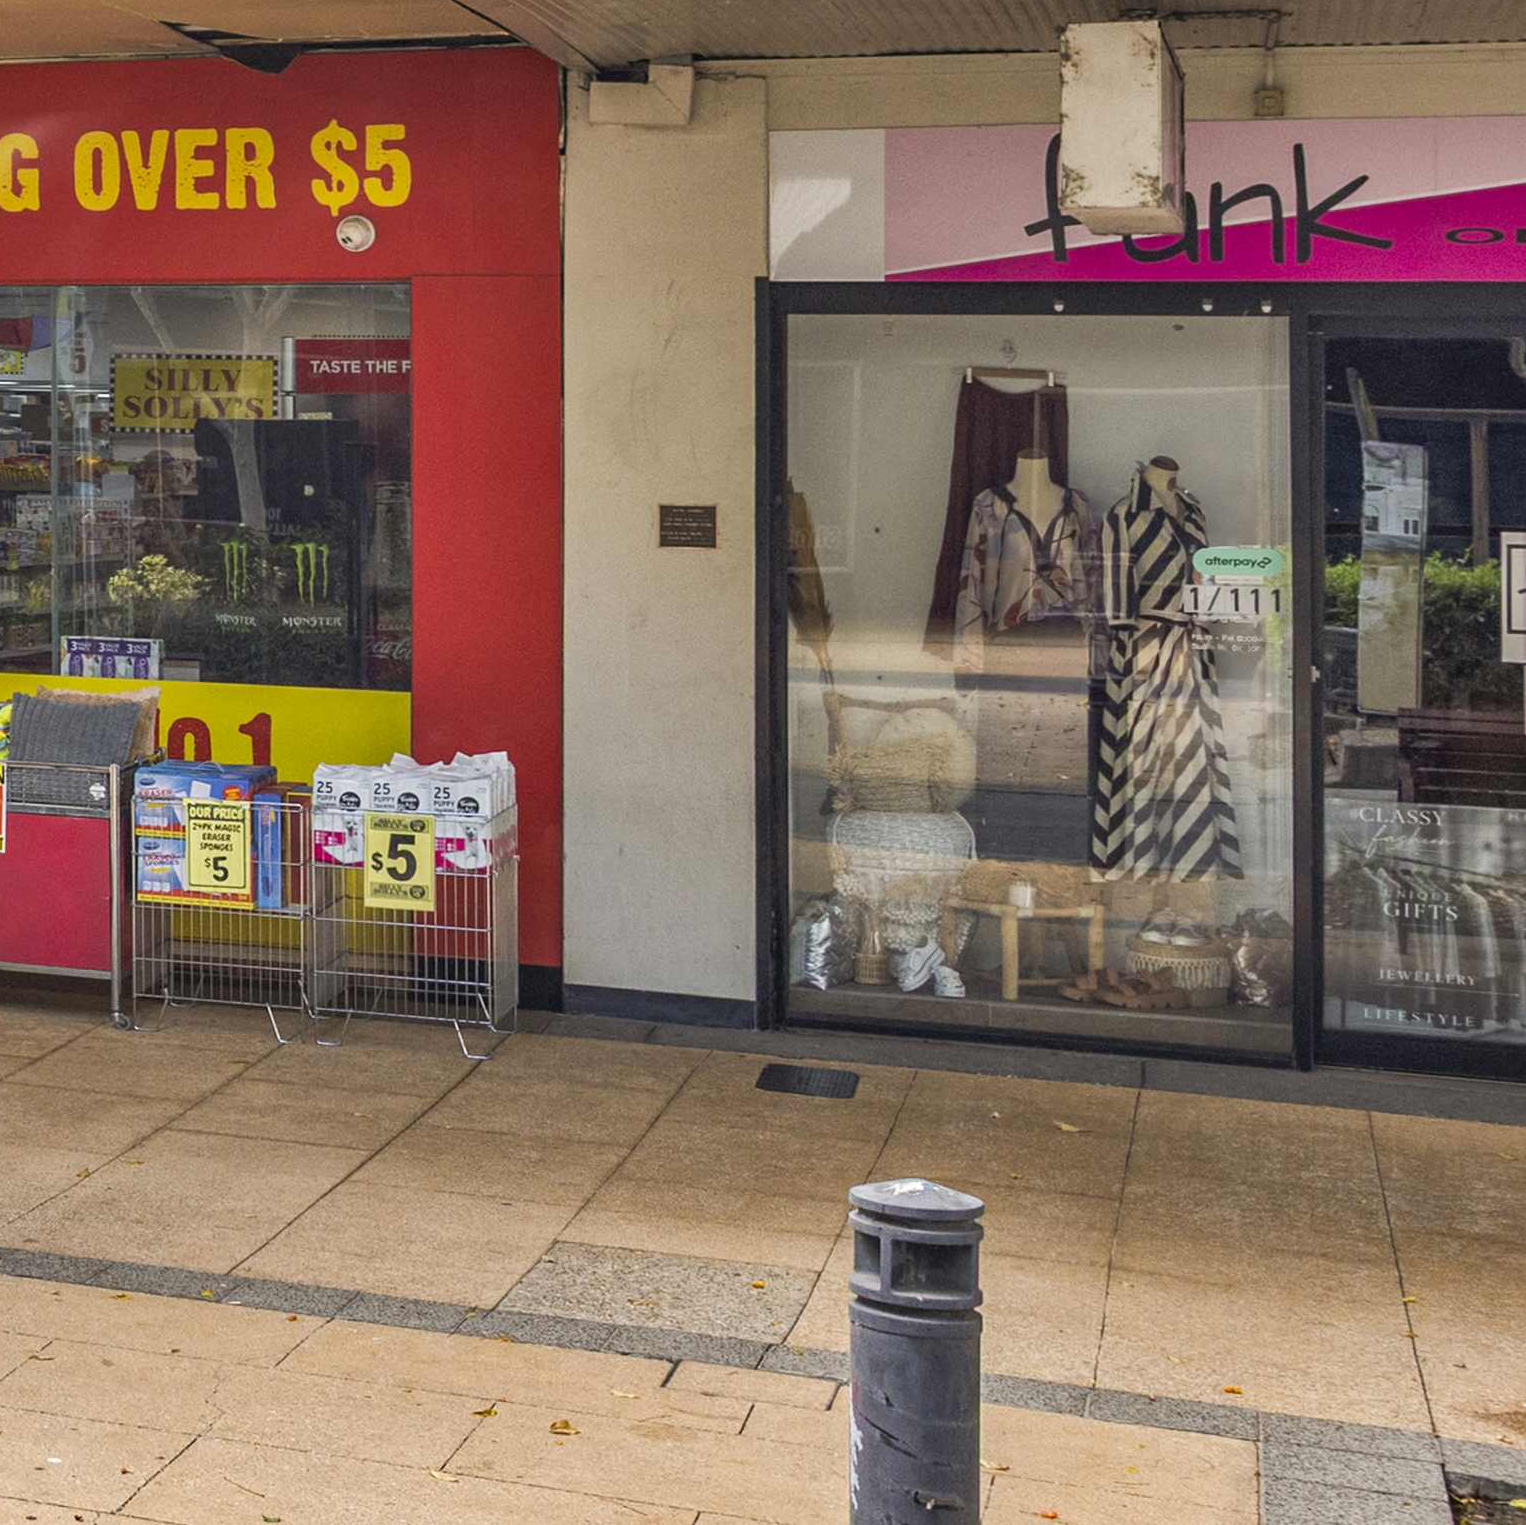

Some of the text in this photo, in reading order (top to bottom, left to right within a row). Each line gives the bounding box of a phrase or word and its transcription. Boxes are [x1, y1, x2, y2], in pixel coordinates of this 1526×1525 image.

[74, 127, 276, 211] OVER
[310, 118, 412, 217] $5
[310, 360, 361, 373] TASTE
[365, 361, 398, 373] THE
[144, 368, 242, 392] SILLY
[123, 396, 264, 419] SOLLY'S
[1205, 556, 1257, 568] afterpay
[282, 616, 342, 627] MONSTER
[71, 641, 77, 651] 3
[98, 642, 105, 652] 3
[127, 643, 133, 653] 3
[317, 781, 333, 794] 25
[374, 783, 390, 795] 25
[434, 786, 450, 799] 25
[317, 794, 337, 802] PUPPY
[374, 796, 395, 804] PUPPY
[433, 800, 455, 808] PUPPY
[189, 807, 244, 820] OUR PRICE
[1359, 806, 1447, 826] CLASSY
[192, 823, 241, 833] 24PK MAGIC
[202, 833, 231, 841] ERASER
[200, 842, 233, 852] SPONGES
[371, 833, 417, 882] $5
[204, 856, 229, 882] $5
[1384, 888, 1453, 903] UNIQUE
[1383, 901, 1458, 922] GIFTS
[1379, 968, 1476, 986] JEWELLERY
[1364, 1007, 1476, 1028] LIFESTYLE
